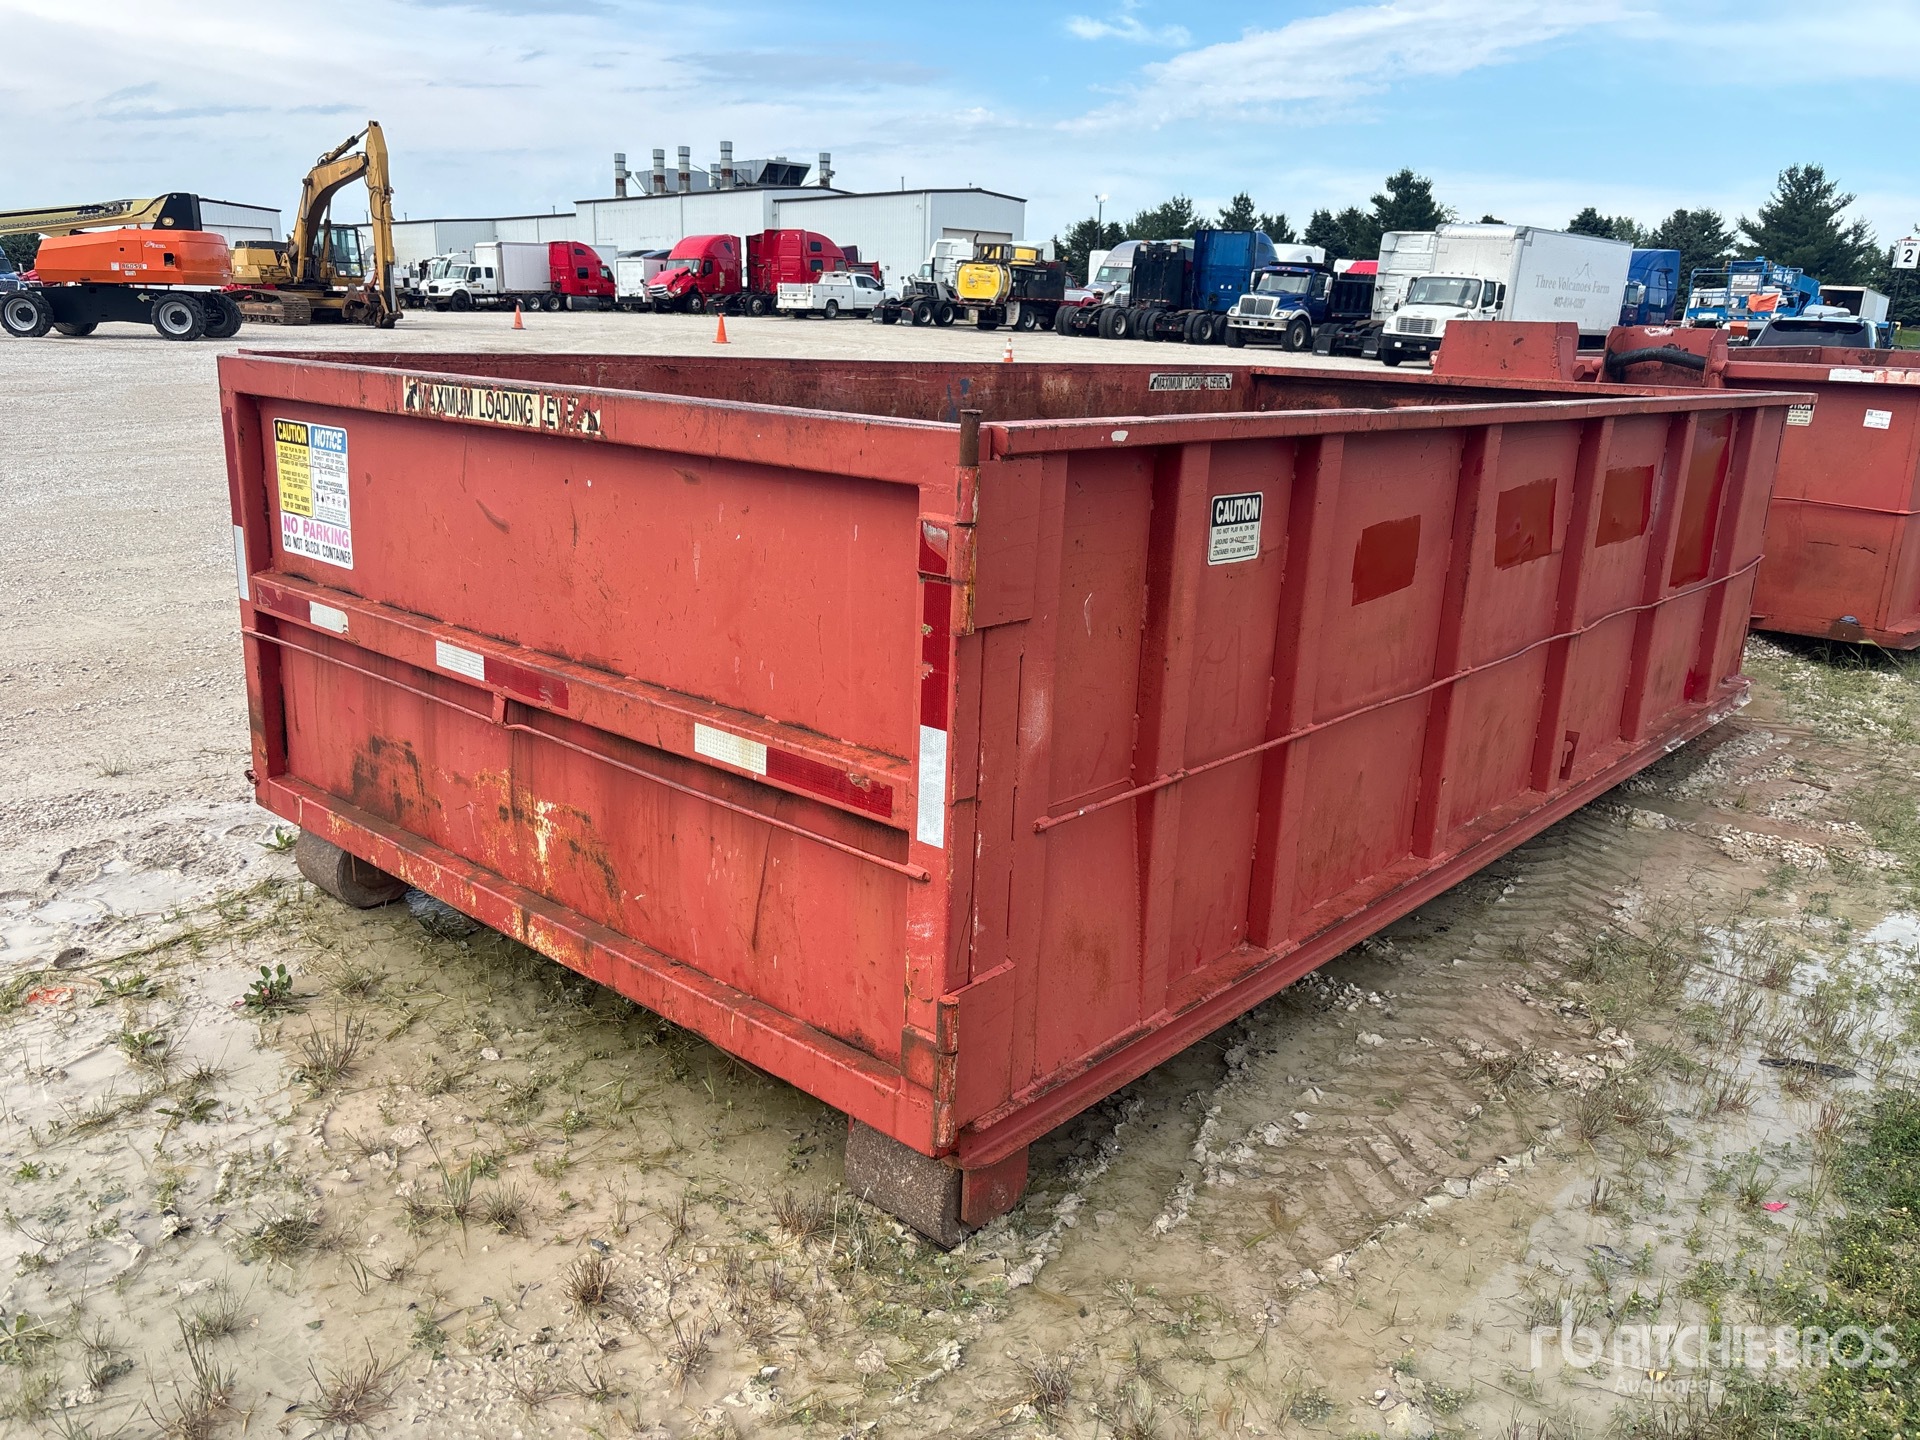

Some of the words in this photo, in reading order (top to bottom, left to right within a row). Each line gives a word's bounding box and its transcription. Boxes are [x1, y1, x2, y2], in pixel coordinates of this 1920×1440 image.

[1903, 249, 1914, 263] 2
[1535, 274, 1557, 290] Three
[1558, 276, 1592, 293] Volcanoes
[1592, 280, 1610, 294] Farm
[1210, 376, 1226, 389] LEVEL
[418, 382, 474, 417] MAXIMUM
[479, 391, 533, 424] LOADING
[277, 421, 307, 444] CAUTION
[314, 428, 343, 451] NOTICE
[1215, 497, 1260, 524] CAUTION
[284, 515, 298, 534] NO
[303, 519, 350, 549] PARKING
[284, 534, 291, 547] DO
[292, 536, 303, 550] NOT
[304, 539, 321, 555] BLOCK
[322, 544, 352, 565] CONTAINER
